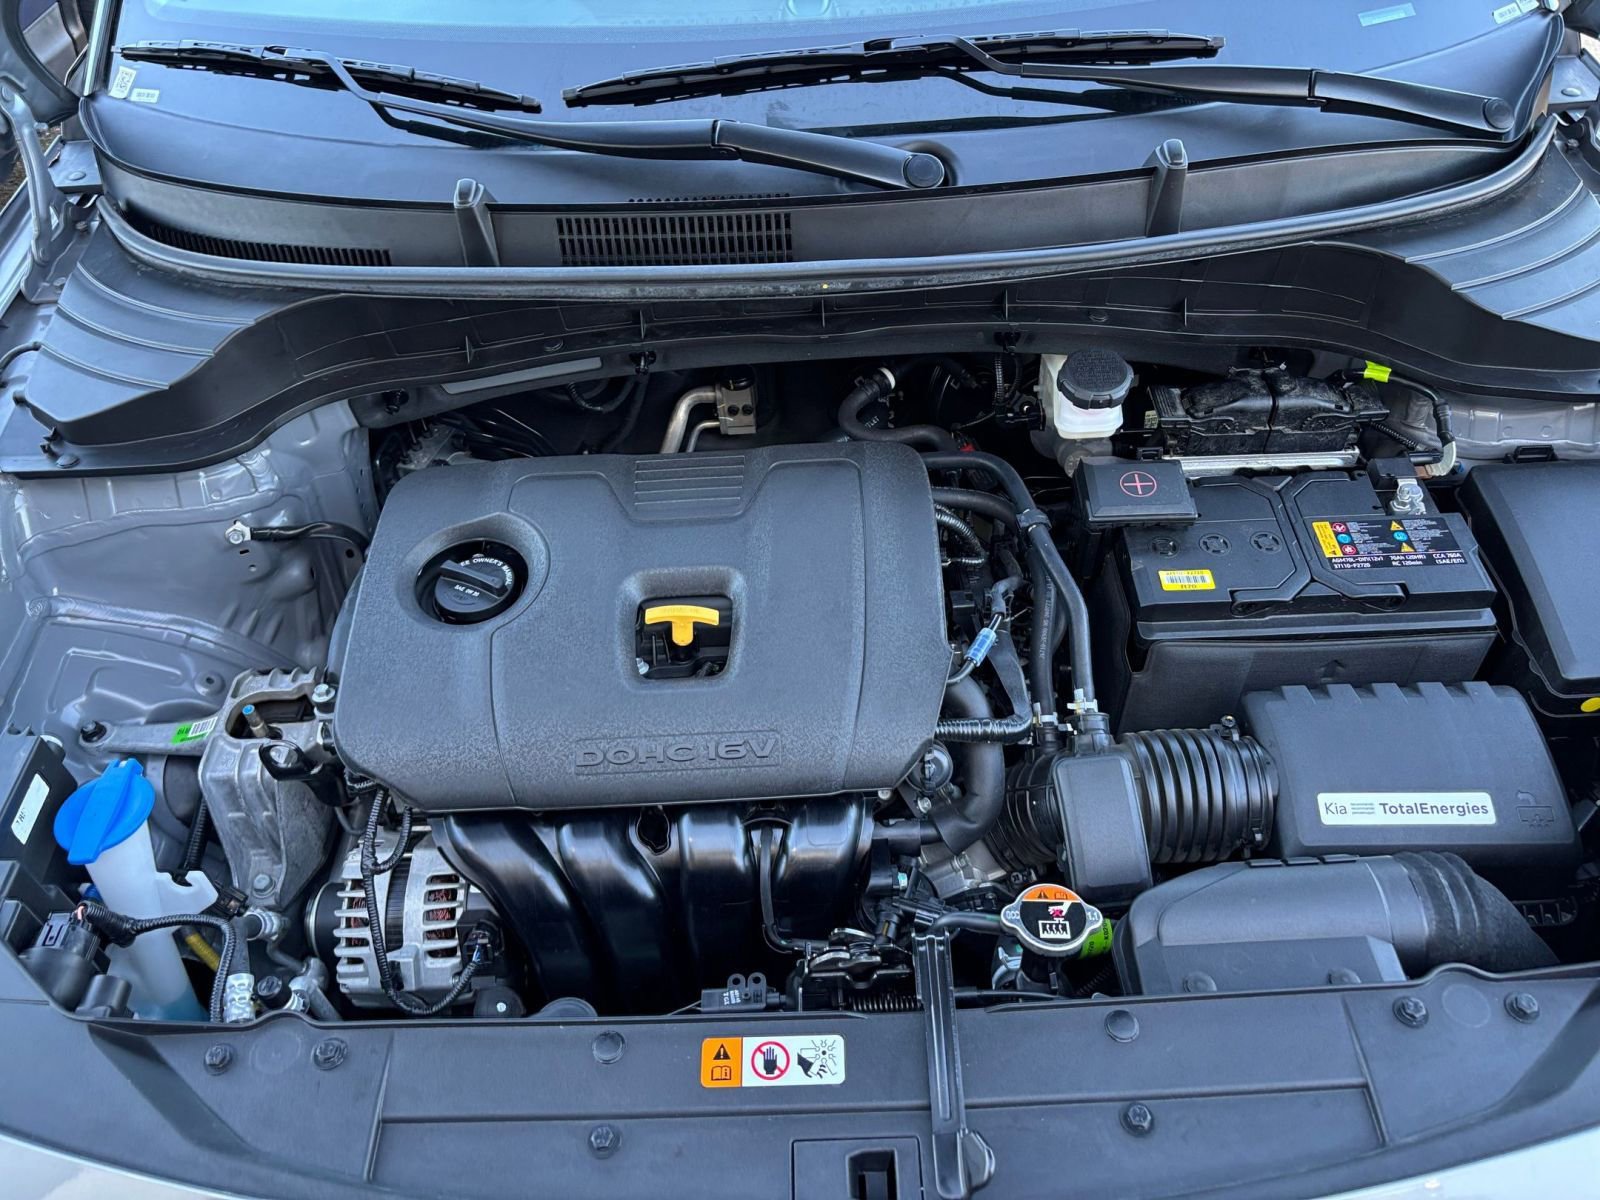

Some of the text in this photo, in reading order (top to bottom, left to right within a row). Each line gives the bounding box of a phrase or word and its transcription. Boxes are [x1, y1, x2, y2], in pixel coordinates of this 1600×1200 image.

[472, 558, 504, 567] OWNER'S
[576, 737, 777, 767] DOHC 16V
[1324, 802, 1347, 815] Kia
[1378, 802, 1489, 817] TotalEnergies
